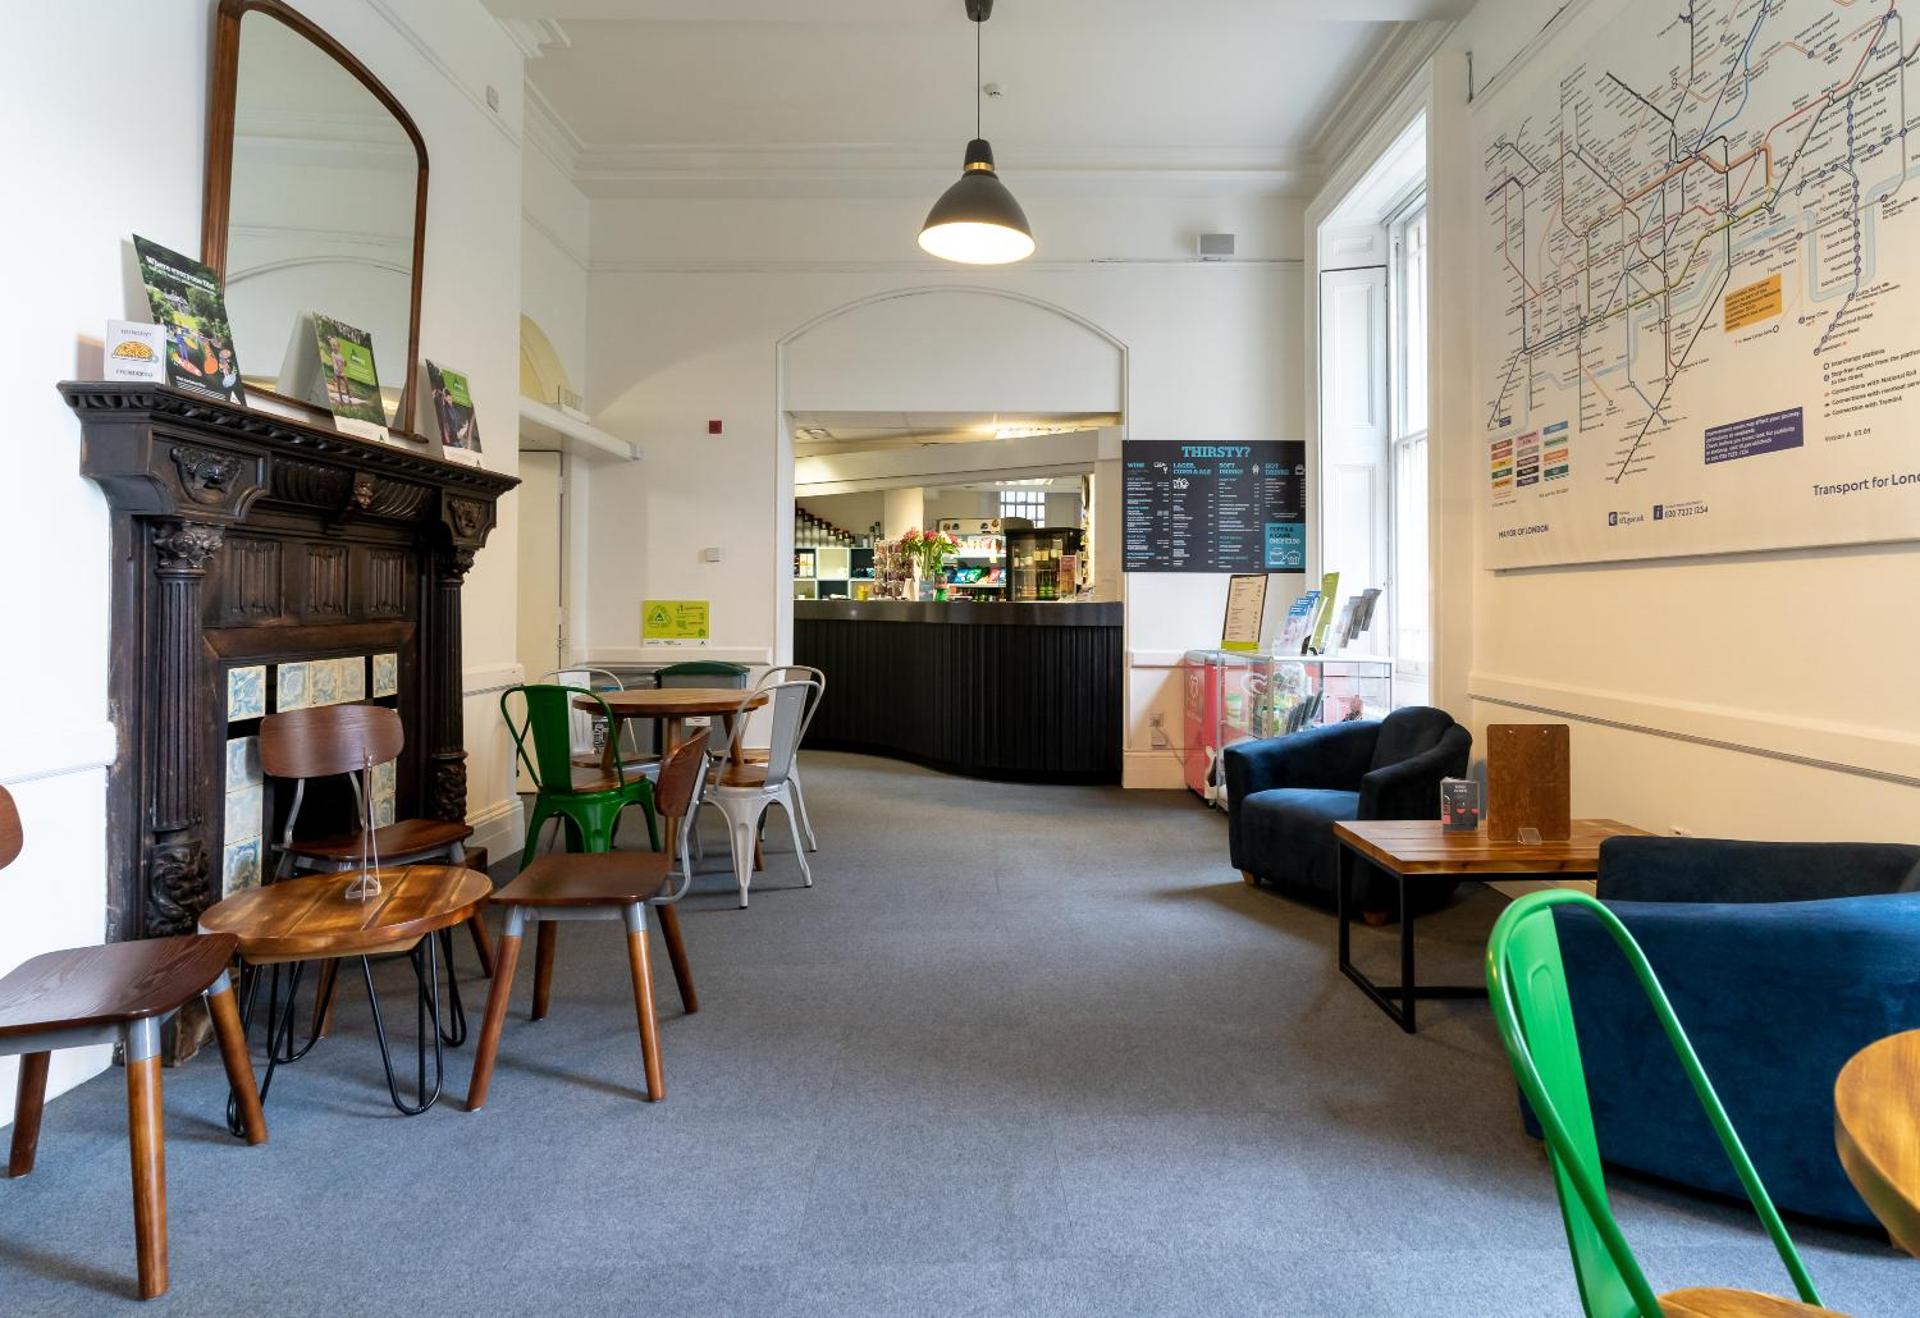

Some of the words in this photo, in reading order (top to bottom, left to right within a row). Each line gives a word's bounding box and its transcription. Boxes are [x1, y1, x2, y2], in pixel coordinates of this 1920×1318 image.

[1181, 446, 1251, 458] THIRSTY?
[1813, 479, 1870, 496] Transport
[1872, 476, 1889, 488] for
[1498, 528, 1516, 540] MAYOR
[1517, 527, 1525, 536] OF
[1525, 523, 1549, 535] LONDON
